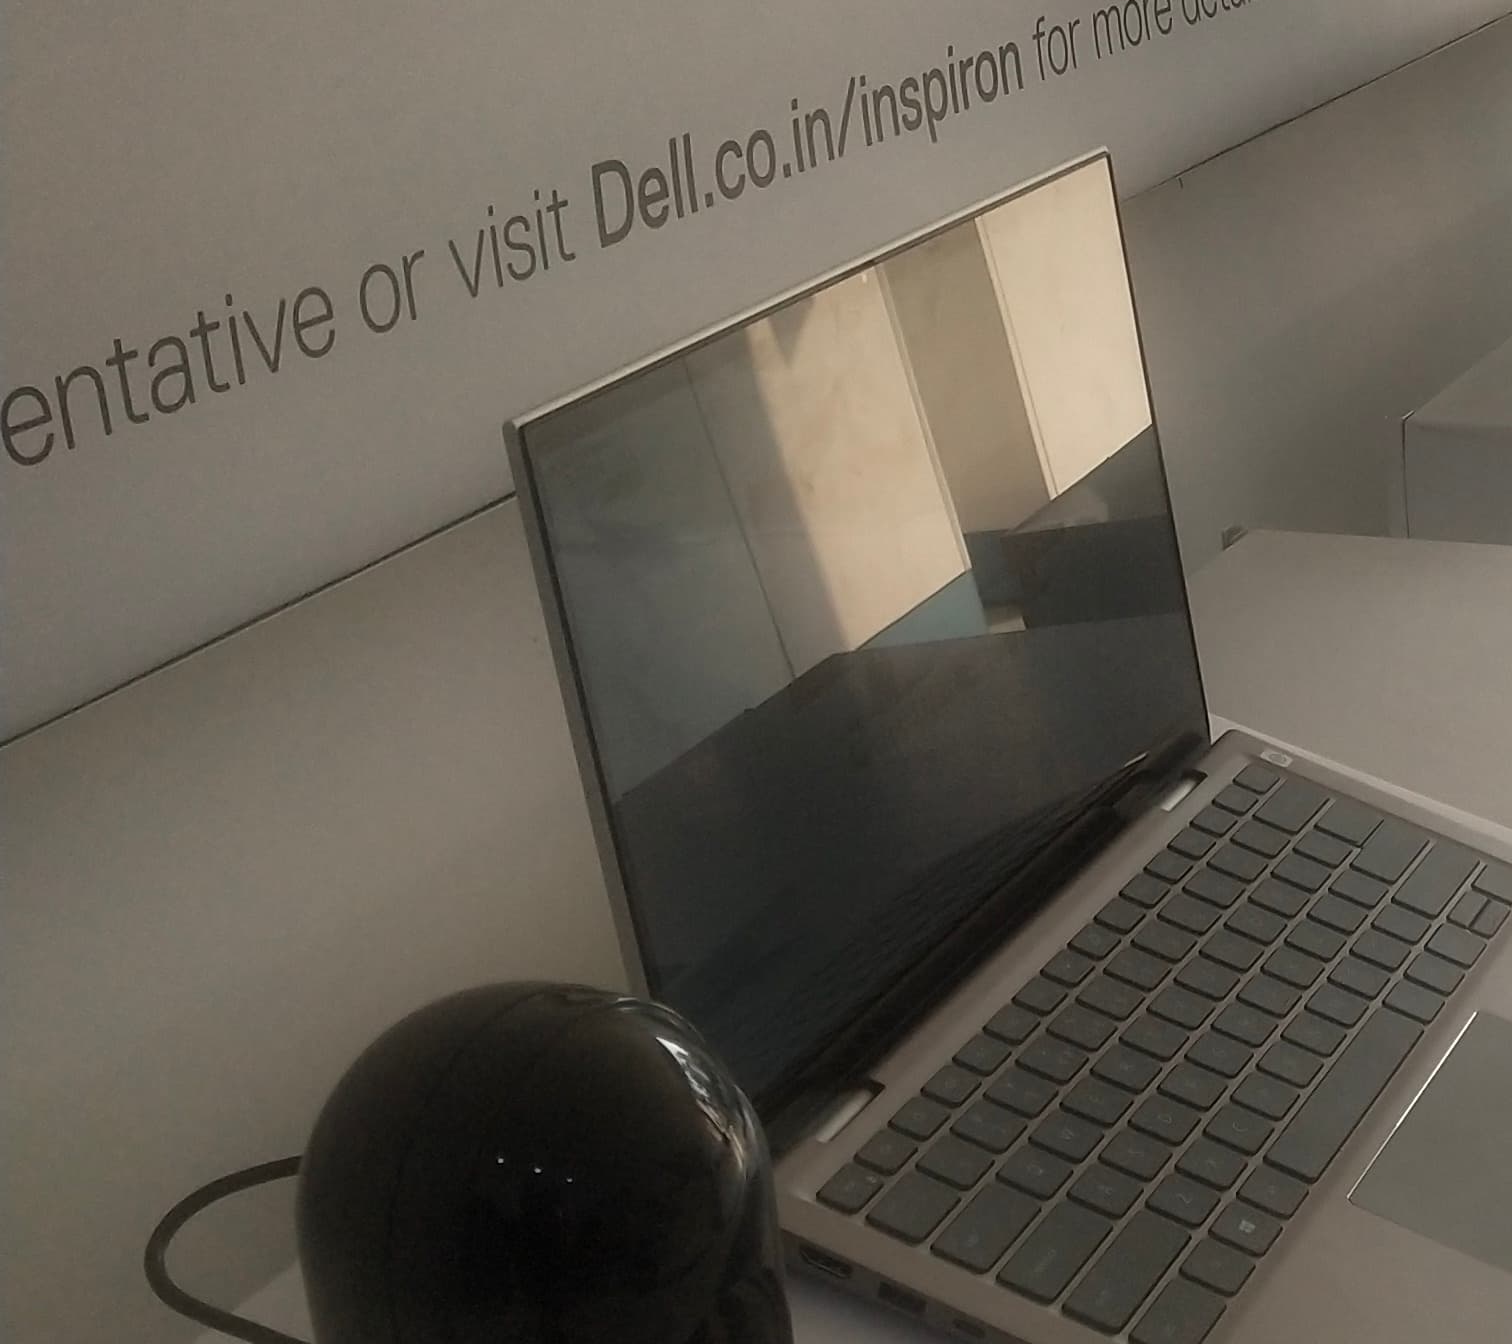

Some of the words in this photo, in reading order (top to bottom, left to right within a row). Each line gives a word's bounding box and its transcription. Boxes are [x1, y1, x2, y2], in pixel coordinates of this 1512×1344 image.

[0, 287, 335, 466] entative
[359, 249, 424, 334] or
[448, 189, 575, 299] visit
[591, 46, 1024, 249] Dell.co.in/inspiron
[1032, 16, 1080, 81] for
